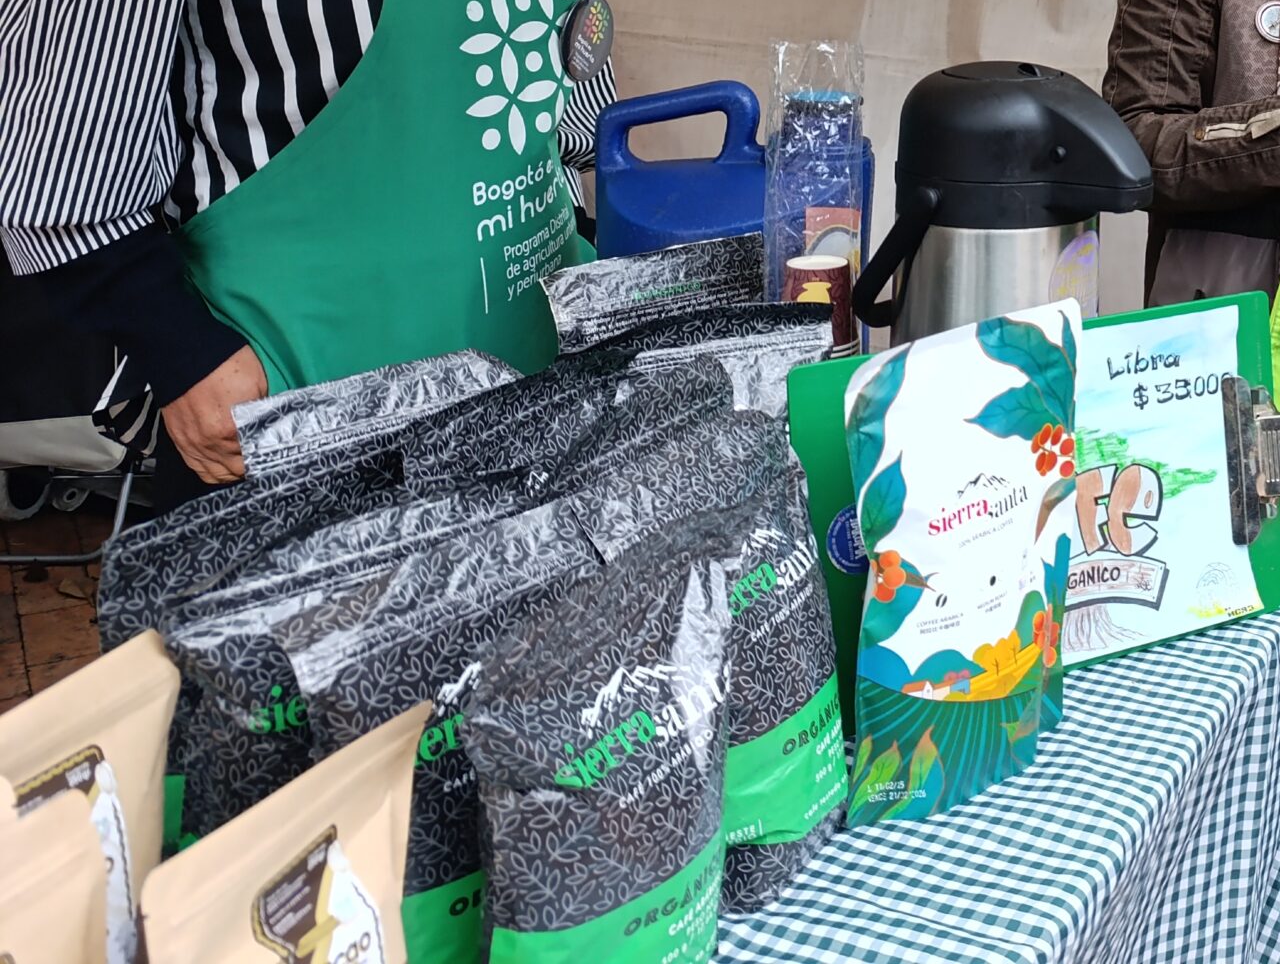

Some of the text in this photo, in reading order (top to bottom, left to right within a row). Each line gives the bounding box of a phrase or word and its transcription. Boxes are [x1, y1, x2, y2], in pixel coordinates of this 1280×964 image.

[472, 161, 544, 206] Bogotá
[477, 205, 513, 242] mi
[504, 227, 550, 262] Programa
[506, 262, 521, 280] de
[507, 283, 515, 302] y
[1107, 345, 1181, 380] Libra
[1067, 566, 1121, 589] GANICO
[782, 693, 840, 756] ORGÁNIC
